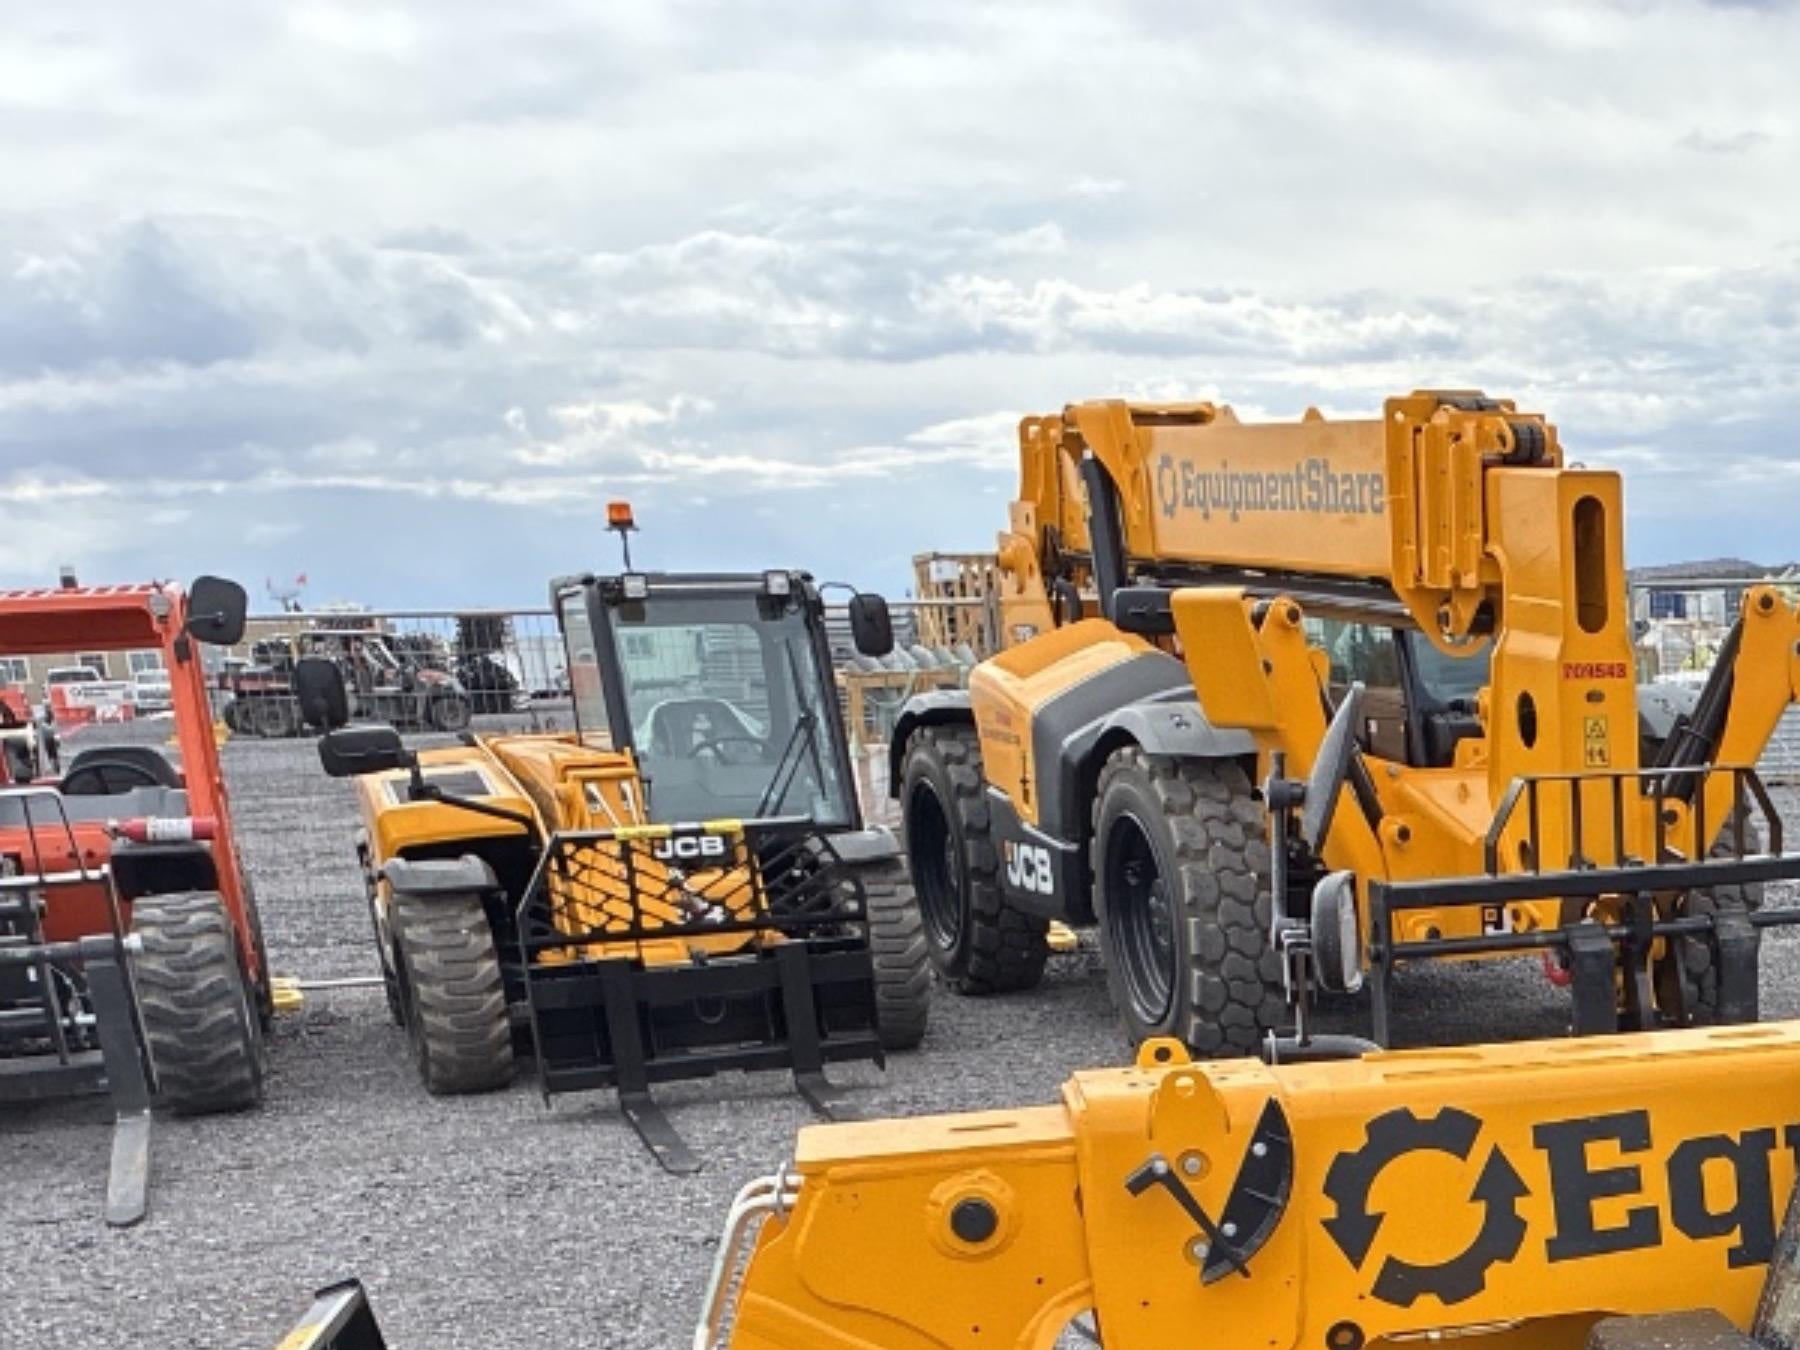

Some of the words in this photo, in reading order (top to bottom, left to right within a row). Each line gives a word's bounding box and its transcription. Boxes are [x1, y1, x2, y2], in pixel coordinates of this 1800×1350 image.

[1180, 457, 1385, 521] EquipmentShare
[653, 836, 724, 859] JCB
[1006, 842, 1054, 895] JCB
